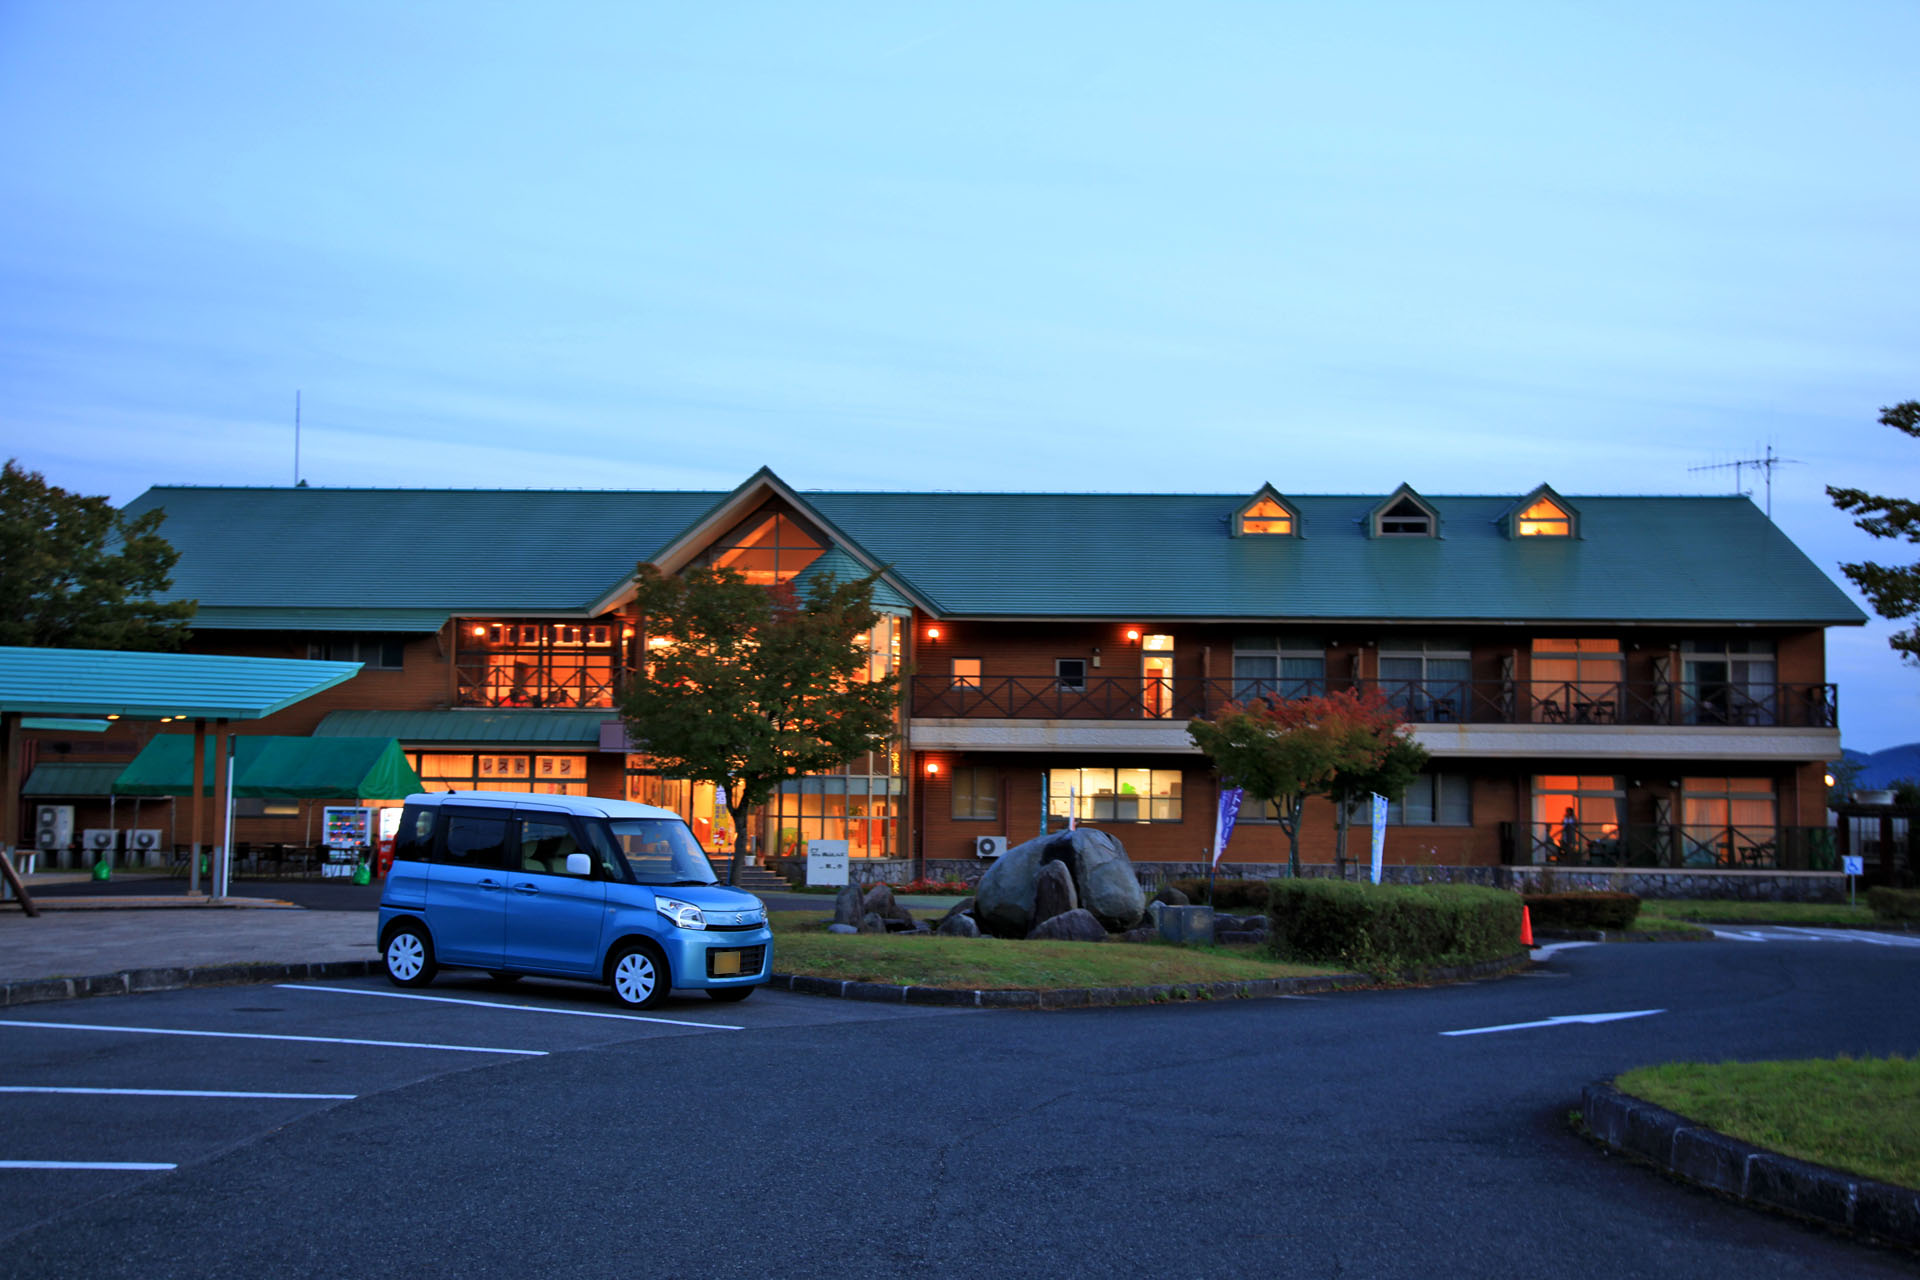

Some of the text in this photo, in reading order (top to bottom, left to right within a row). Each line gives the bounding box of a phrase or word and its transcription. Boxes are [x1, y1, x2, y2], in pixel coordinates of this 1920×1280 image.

[483, 761, 570, 773] レストラン
